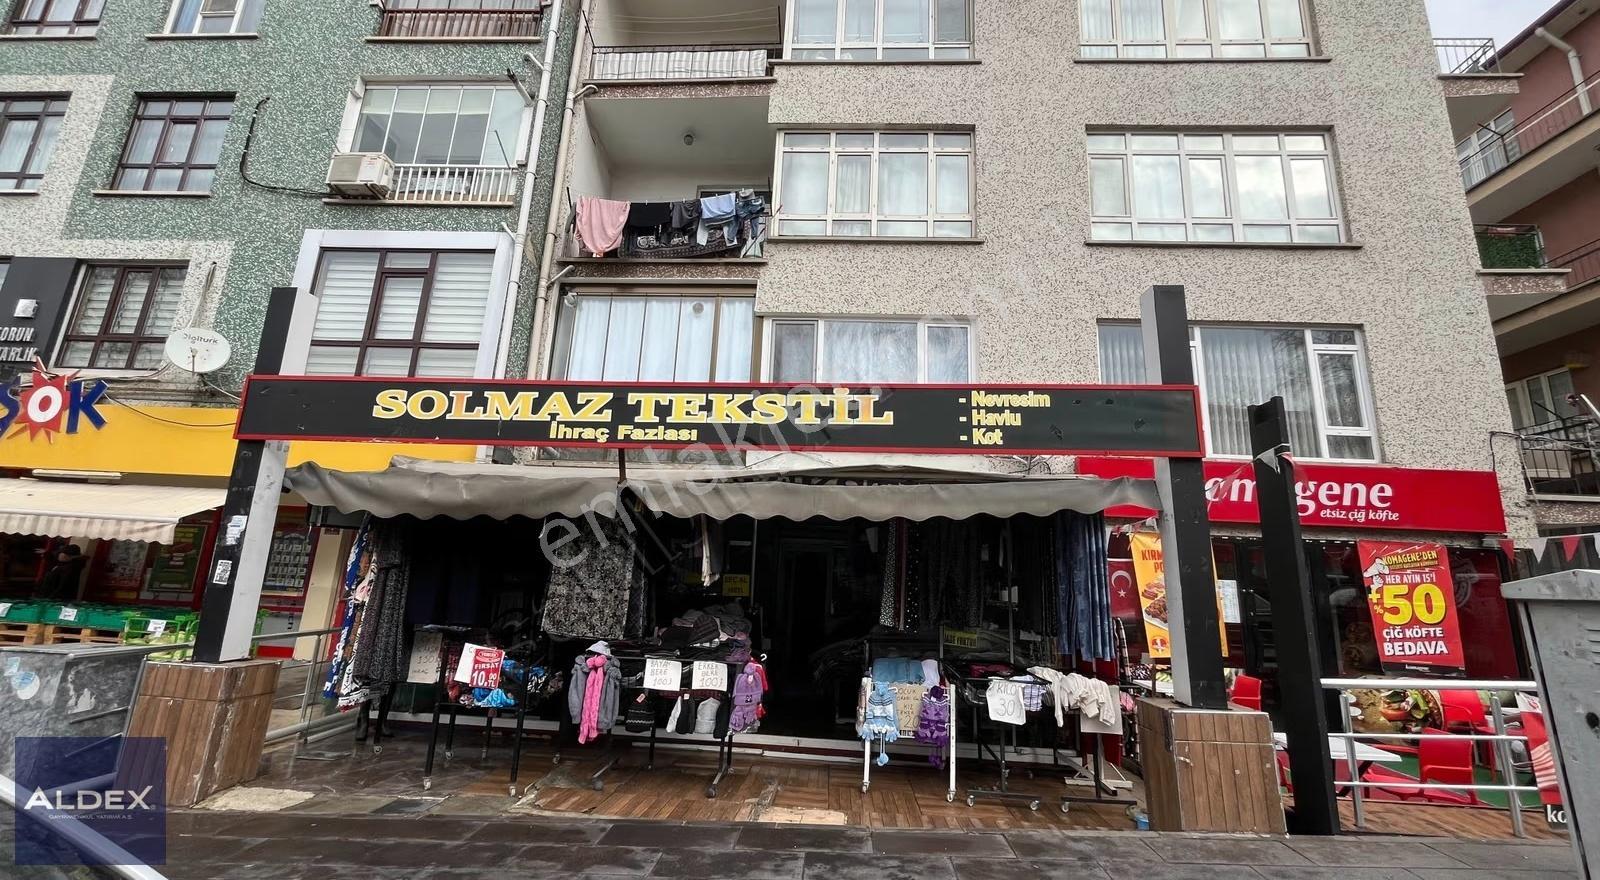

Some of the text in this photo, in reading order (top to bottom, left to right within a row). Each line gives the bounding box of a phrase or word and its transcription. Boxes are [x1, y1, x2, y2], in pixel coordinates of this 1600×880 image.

[0, 327, 34, 341] ORUN
[372, 387, 894, 425] SOLMAZ TEKSTİL
[971, 391, 1051, 407] Nevresim
[972, 410, 1022, 426] Havlu
[549, 420, 698, 443] İhraç Fazlası
[973, 429, 1003, 444] Kot
[1320, 508, 1399, 522] etsiz çiğ köfte
[1385, 575, 1401, 584] HER
[1403, 574, 1420, 583] AYIN
[1383, 625, 1444, 641] ÇİĞ KÖFTE
[1383, 641, 1448, 655] BEDAVA
